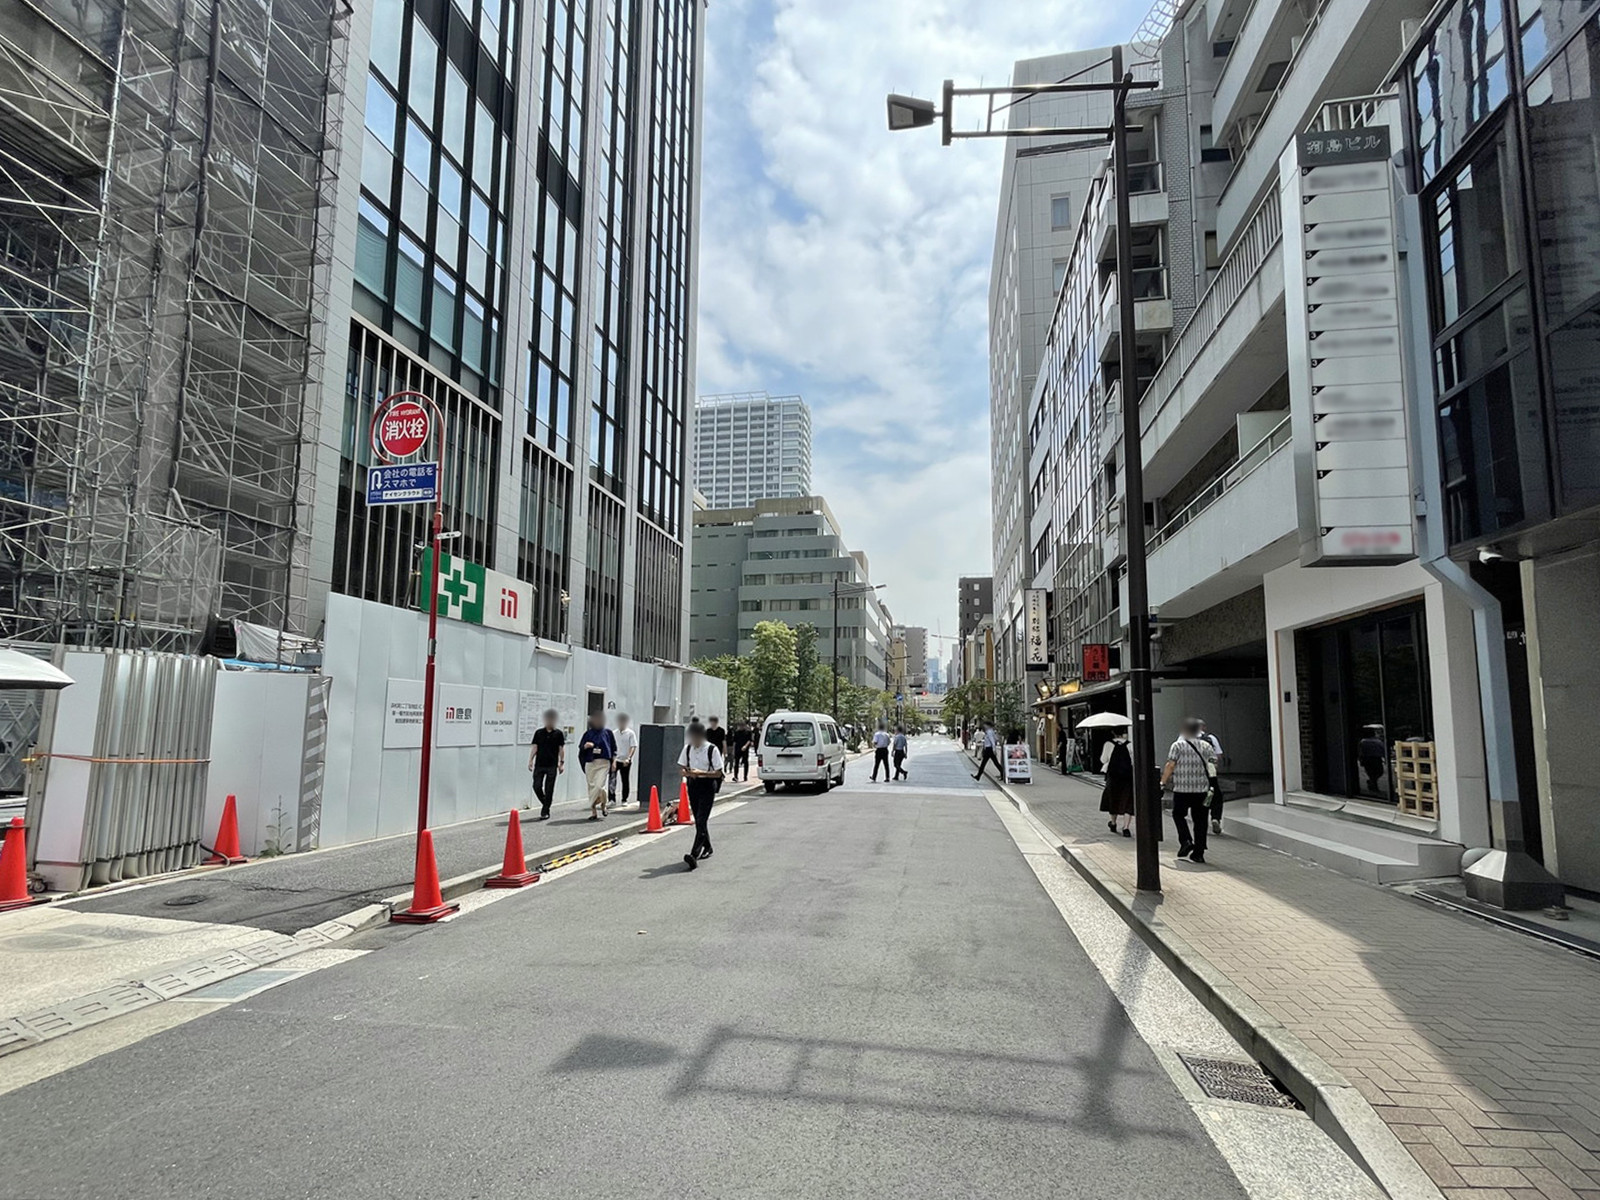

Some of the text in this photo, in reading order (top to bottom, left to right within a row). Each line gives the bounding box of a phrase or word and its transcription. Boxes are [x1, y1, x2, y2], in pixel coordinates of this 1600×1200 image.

[385, 417, 426, 441] 消火栓
[383, 466, 434, 479] 会社の電話を
[383, 478, 417, 489] スマホで
